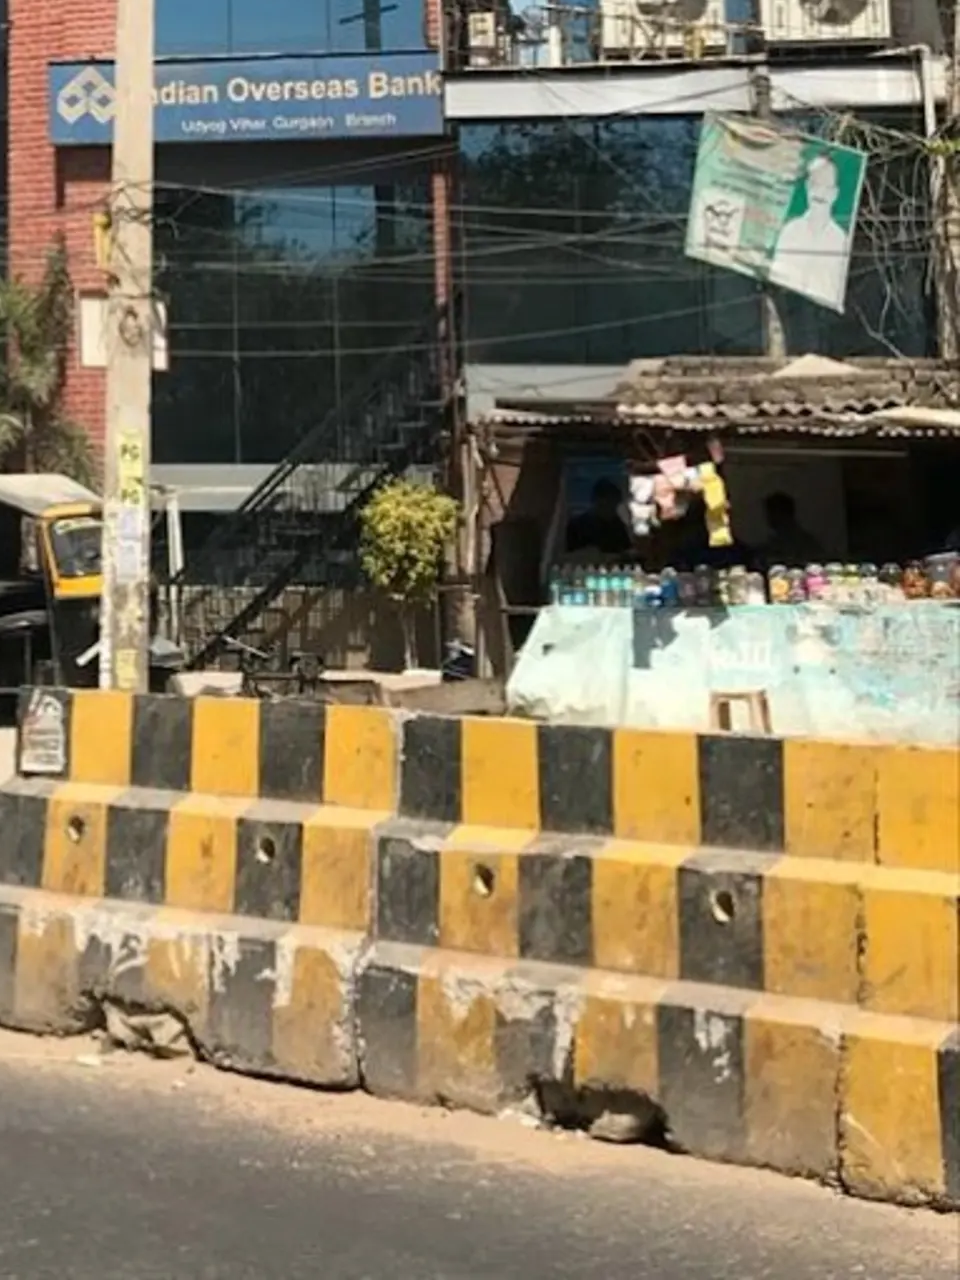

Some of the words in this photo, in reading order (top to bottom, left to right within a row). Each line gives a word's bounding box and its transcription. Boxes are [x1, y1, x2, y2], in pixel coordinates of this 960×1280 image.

[151, 79, 219, 105] dian
[227, 76, 359, 103] Overseas
[368, 70, 442, 99] Bank
[345, 112, 397, 127] Branch
